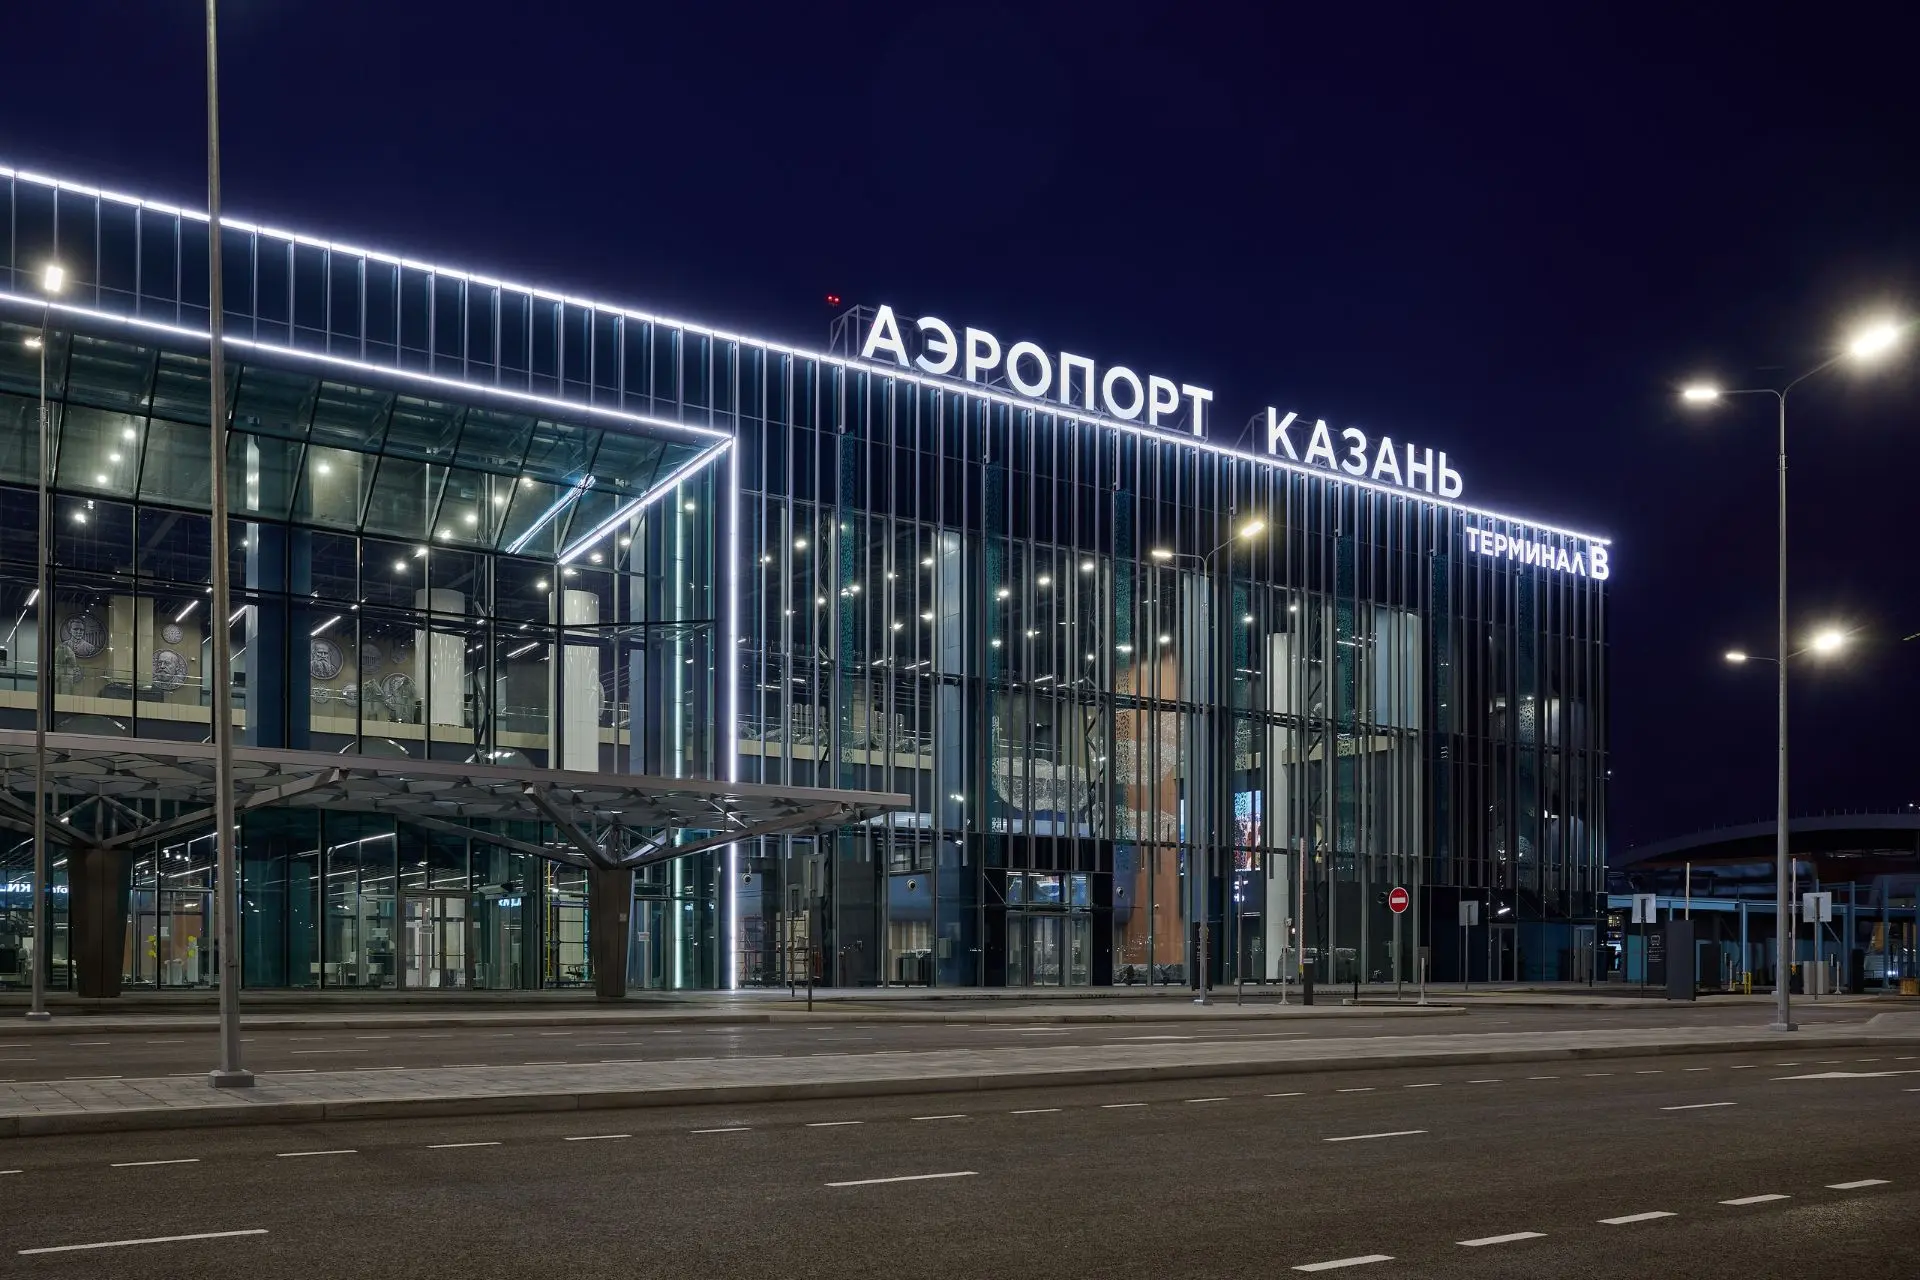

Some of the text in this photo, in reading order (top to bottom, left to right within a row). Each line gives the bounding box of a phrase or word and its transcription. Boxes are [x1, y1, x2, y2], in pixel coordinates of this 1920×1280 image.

[861, 304, 1463, 499] АЭРОПОРТ КАЗАНЬ
[1466, 526, 1586, 577] ТЕРМИНАЛ
